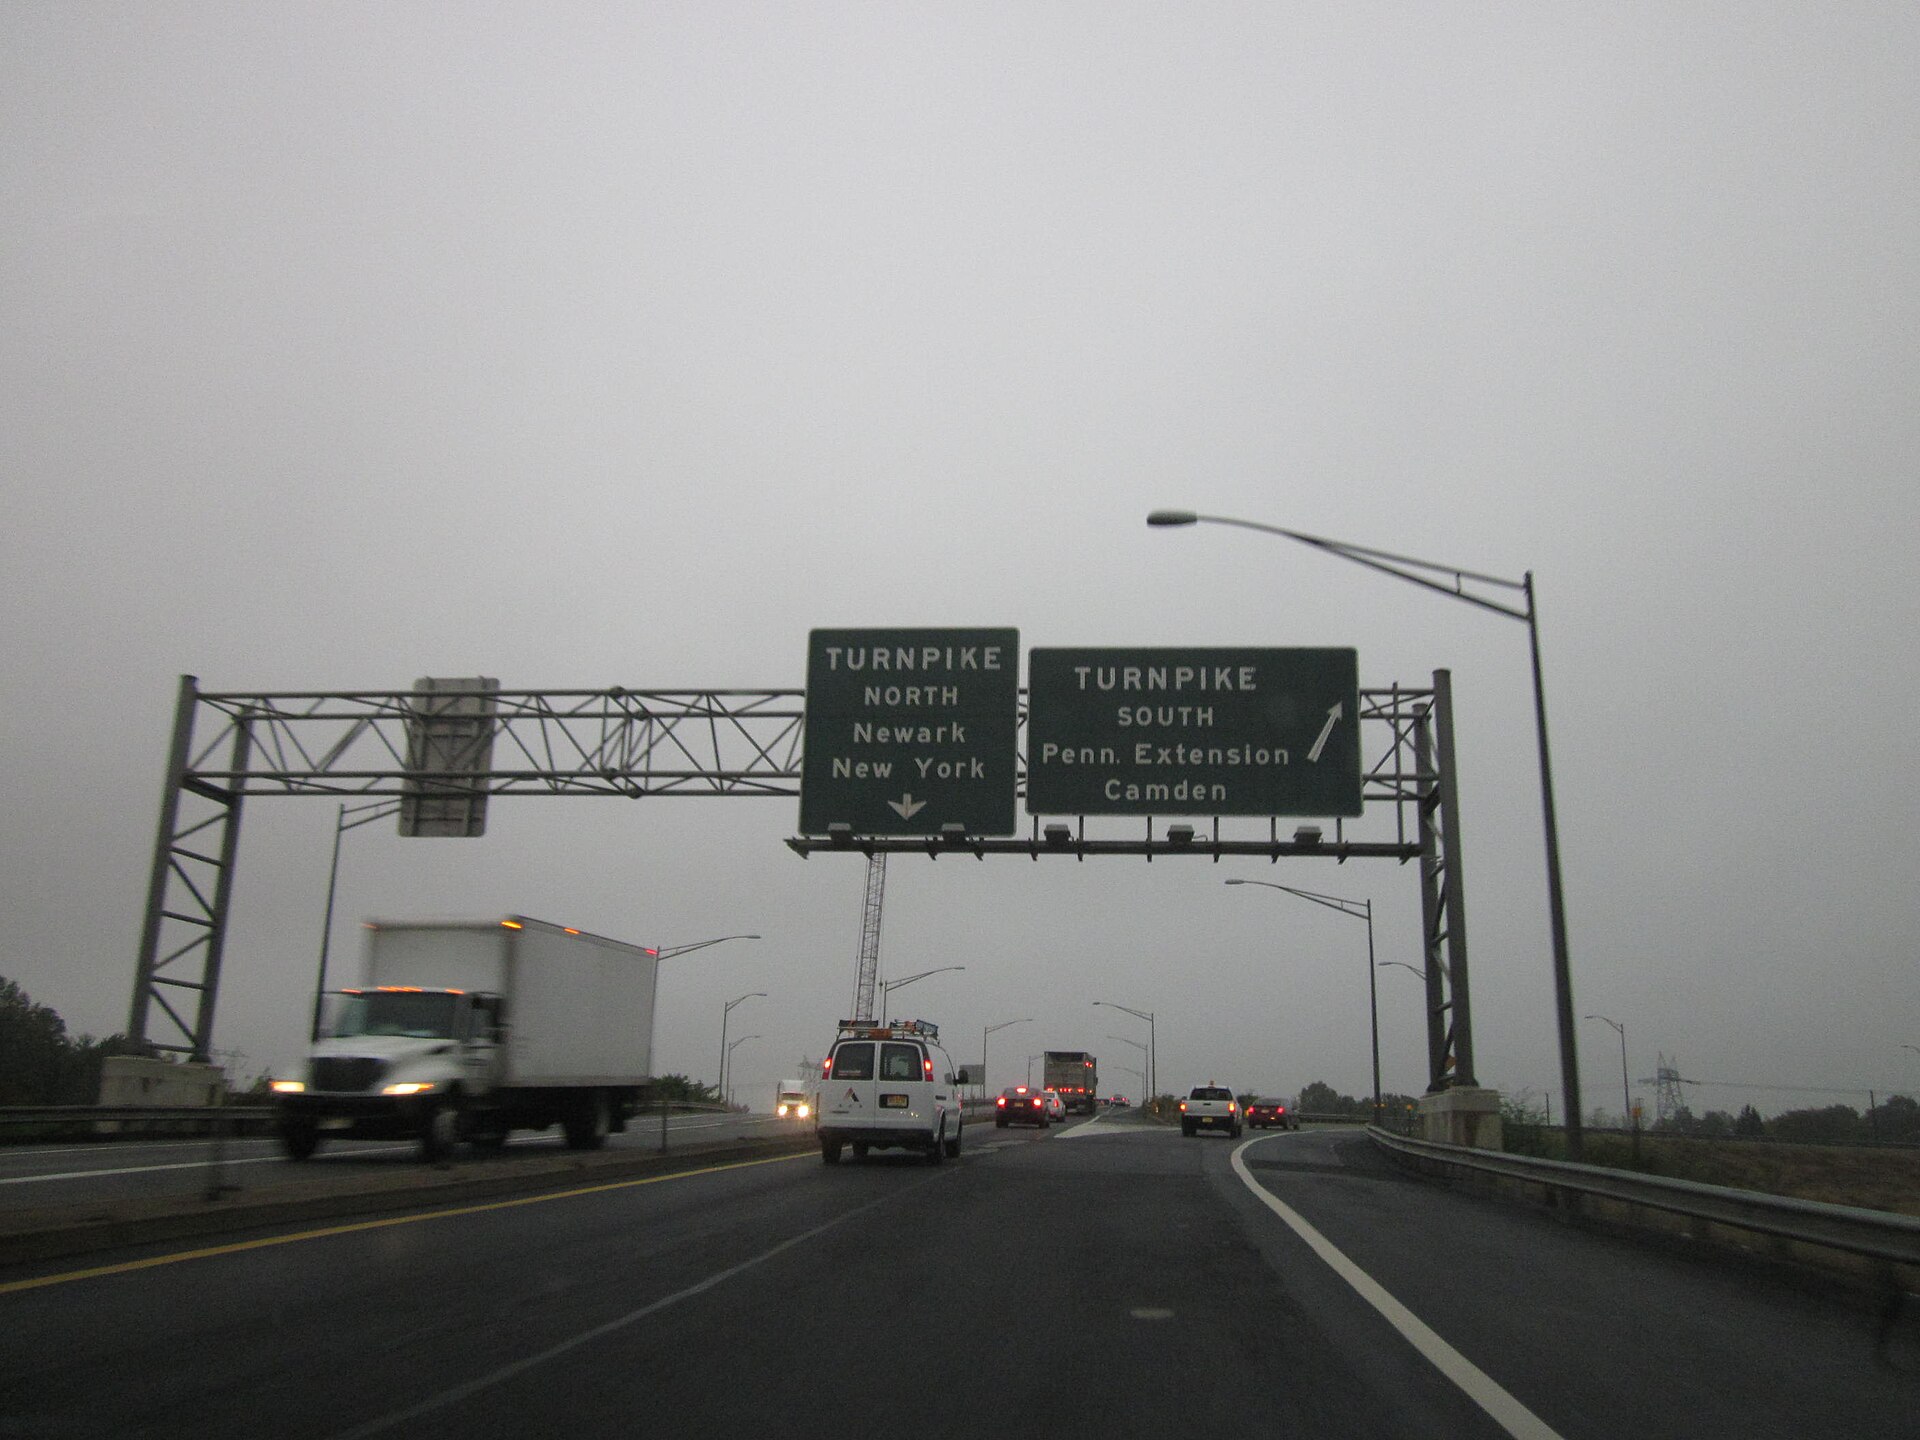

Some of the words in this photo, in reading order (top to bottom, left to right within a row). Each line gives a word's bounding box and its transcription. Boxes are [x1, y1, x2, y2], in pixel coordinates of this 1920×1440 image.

[826, 646, 1001, 671] TURNPIKE
[1075, 667, 1257, 691] TURNPIKE
[864, 686, 958, 706] NORTH
[1117, 706, 1214, 727] SOUTH
[853, 722, 966, 744] Newark
[1042, 743, 1121, 765] Penn.
[1135, 743, 1289, 765] Extension
[832, 758, 893, 779] New
[914, 757, 985, 779] York
[1104, 779, 1227, 801] Camden
